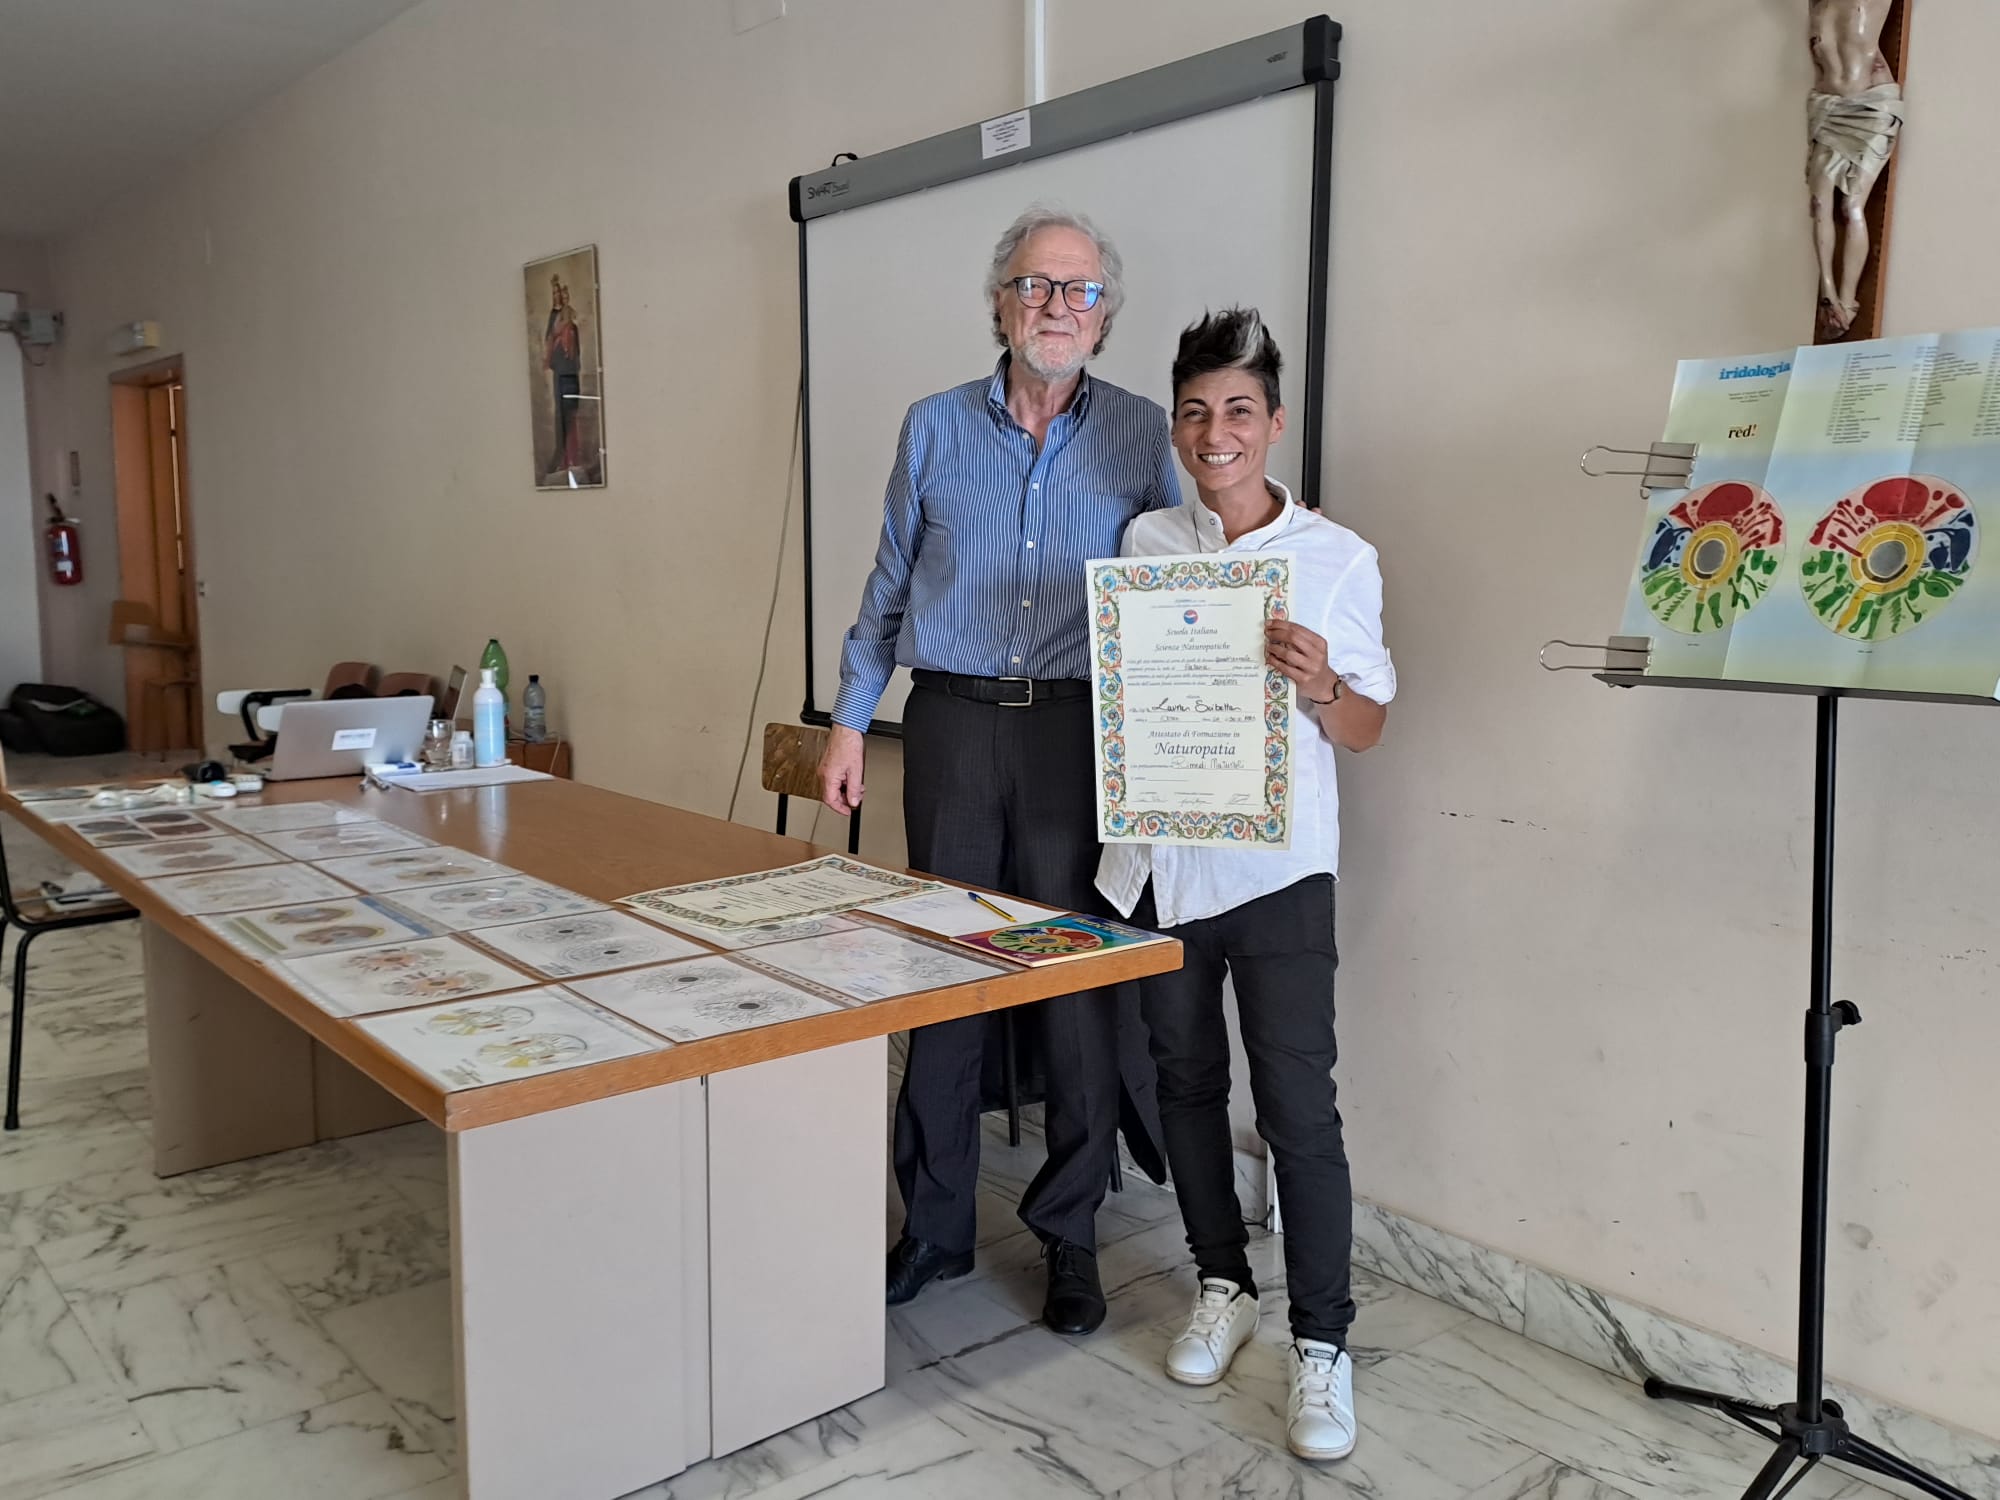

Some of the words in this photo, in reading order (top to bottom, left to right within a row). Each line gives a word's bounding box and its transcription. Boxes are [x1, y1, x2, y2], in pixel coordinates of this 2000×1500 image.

[1719, 361, 1791, 380] iridologia
[1728, 424, 1757, 439] red!
[1147, 730, 1181, 739] Attestato
[1182, 730, 1190, 738] di
[1191, 730, 1232, 738] Formazione
[1154, 741, 1236, 759] Naturopatia
